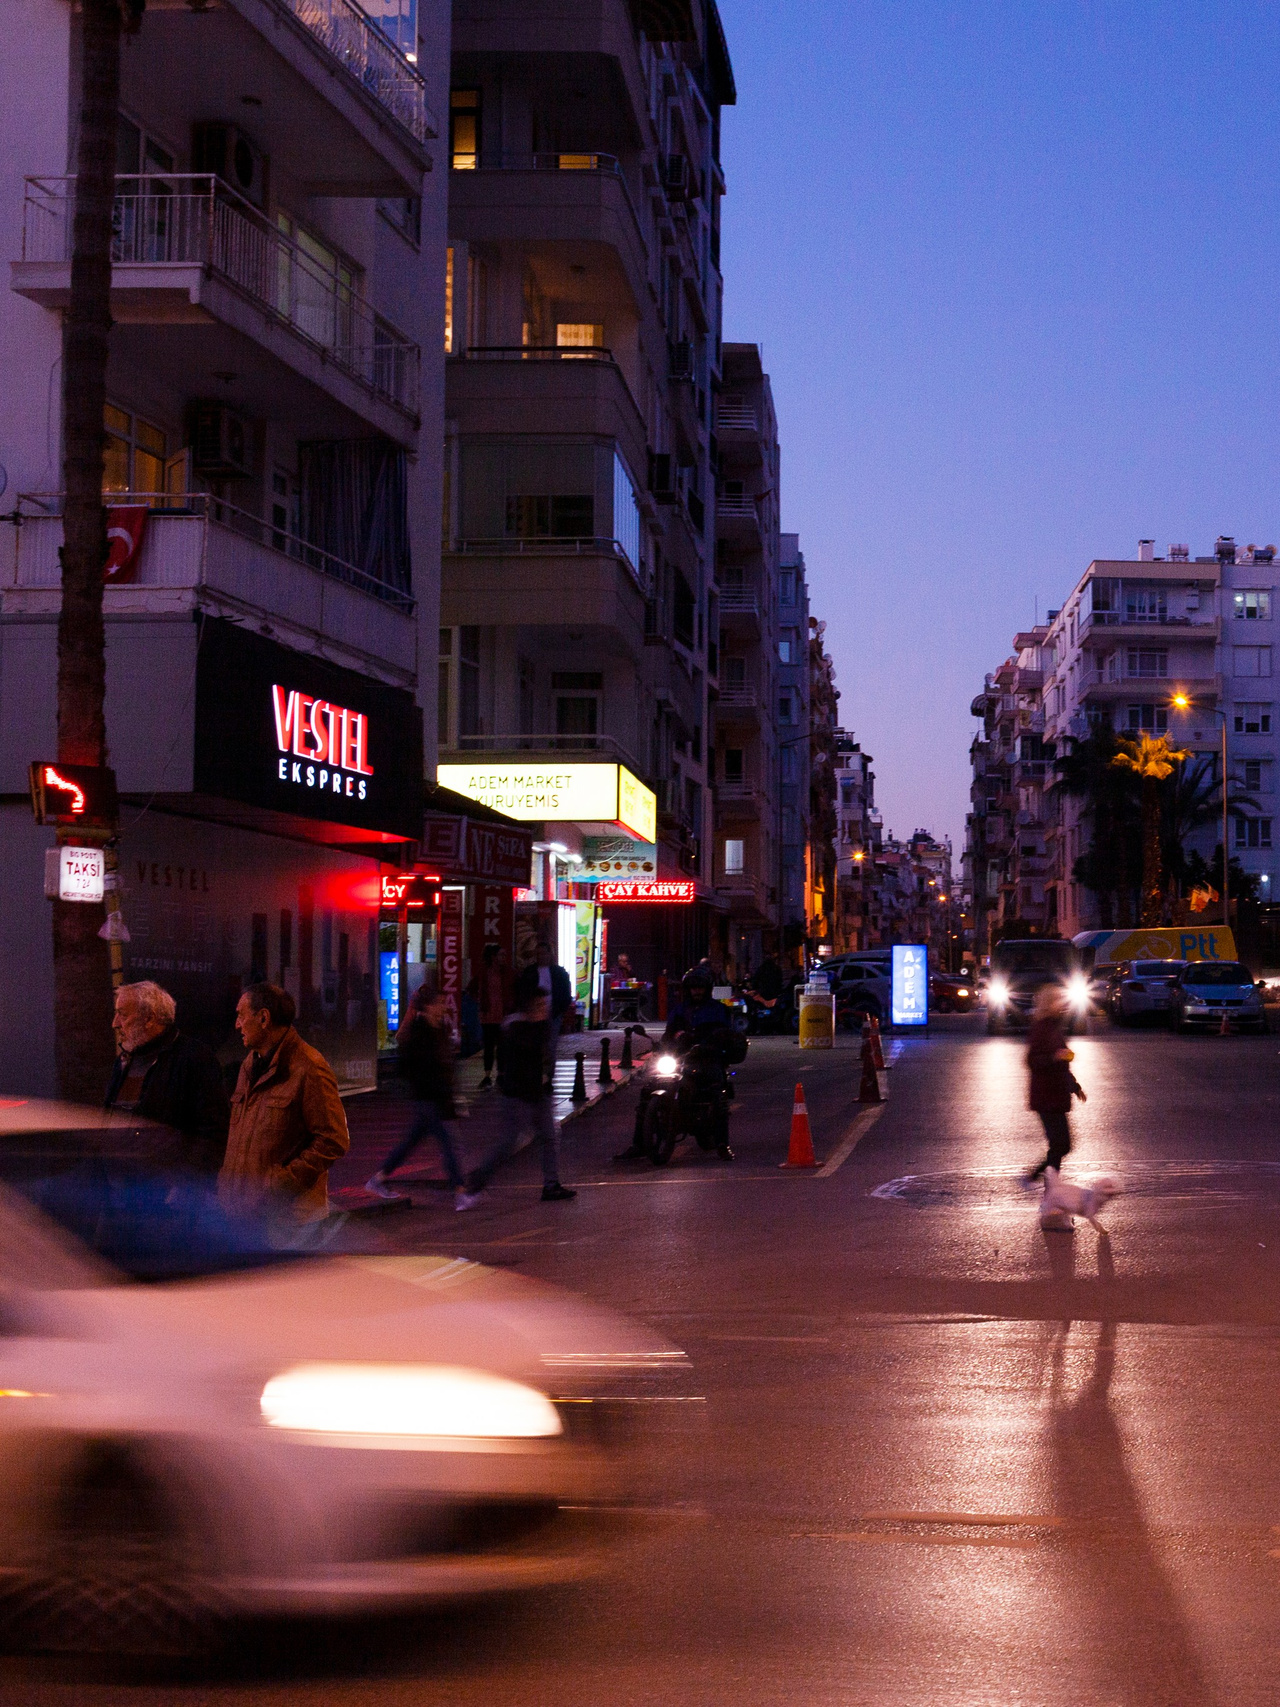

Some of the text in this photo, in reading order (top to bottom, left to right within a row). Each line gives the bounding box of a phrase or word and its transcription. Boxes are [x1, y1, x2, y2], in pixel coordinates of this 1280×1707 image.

[272, 683, 374, 776] VESTEL
[278, 758, 367, 800] EKSPRES
[468, 774, 572, 789] ADEM MARKET
[66, 860, 100, 877] TAKSİ
[136, 859, 210, 893] VESTEL
[604, 884, 689, 898] ÇAY KAHVE
[1180, 933, 1220, 960] Ptt
[903, 950, 916, 1010] ADEM
